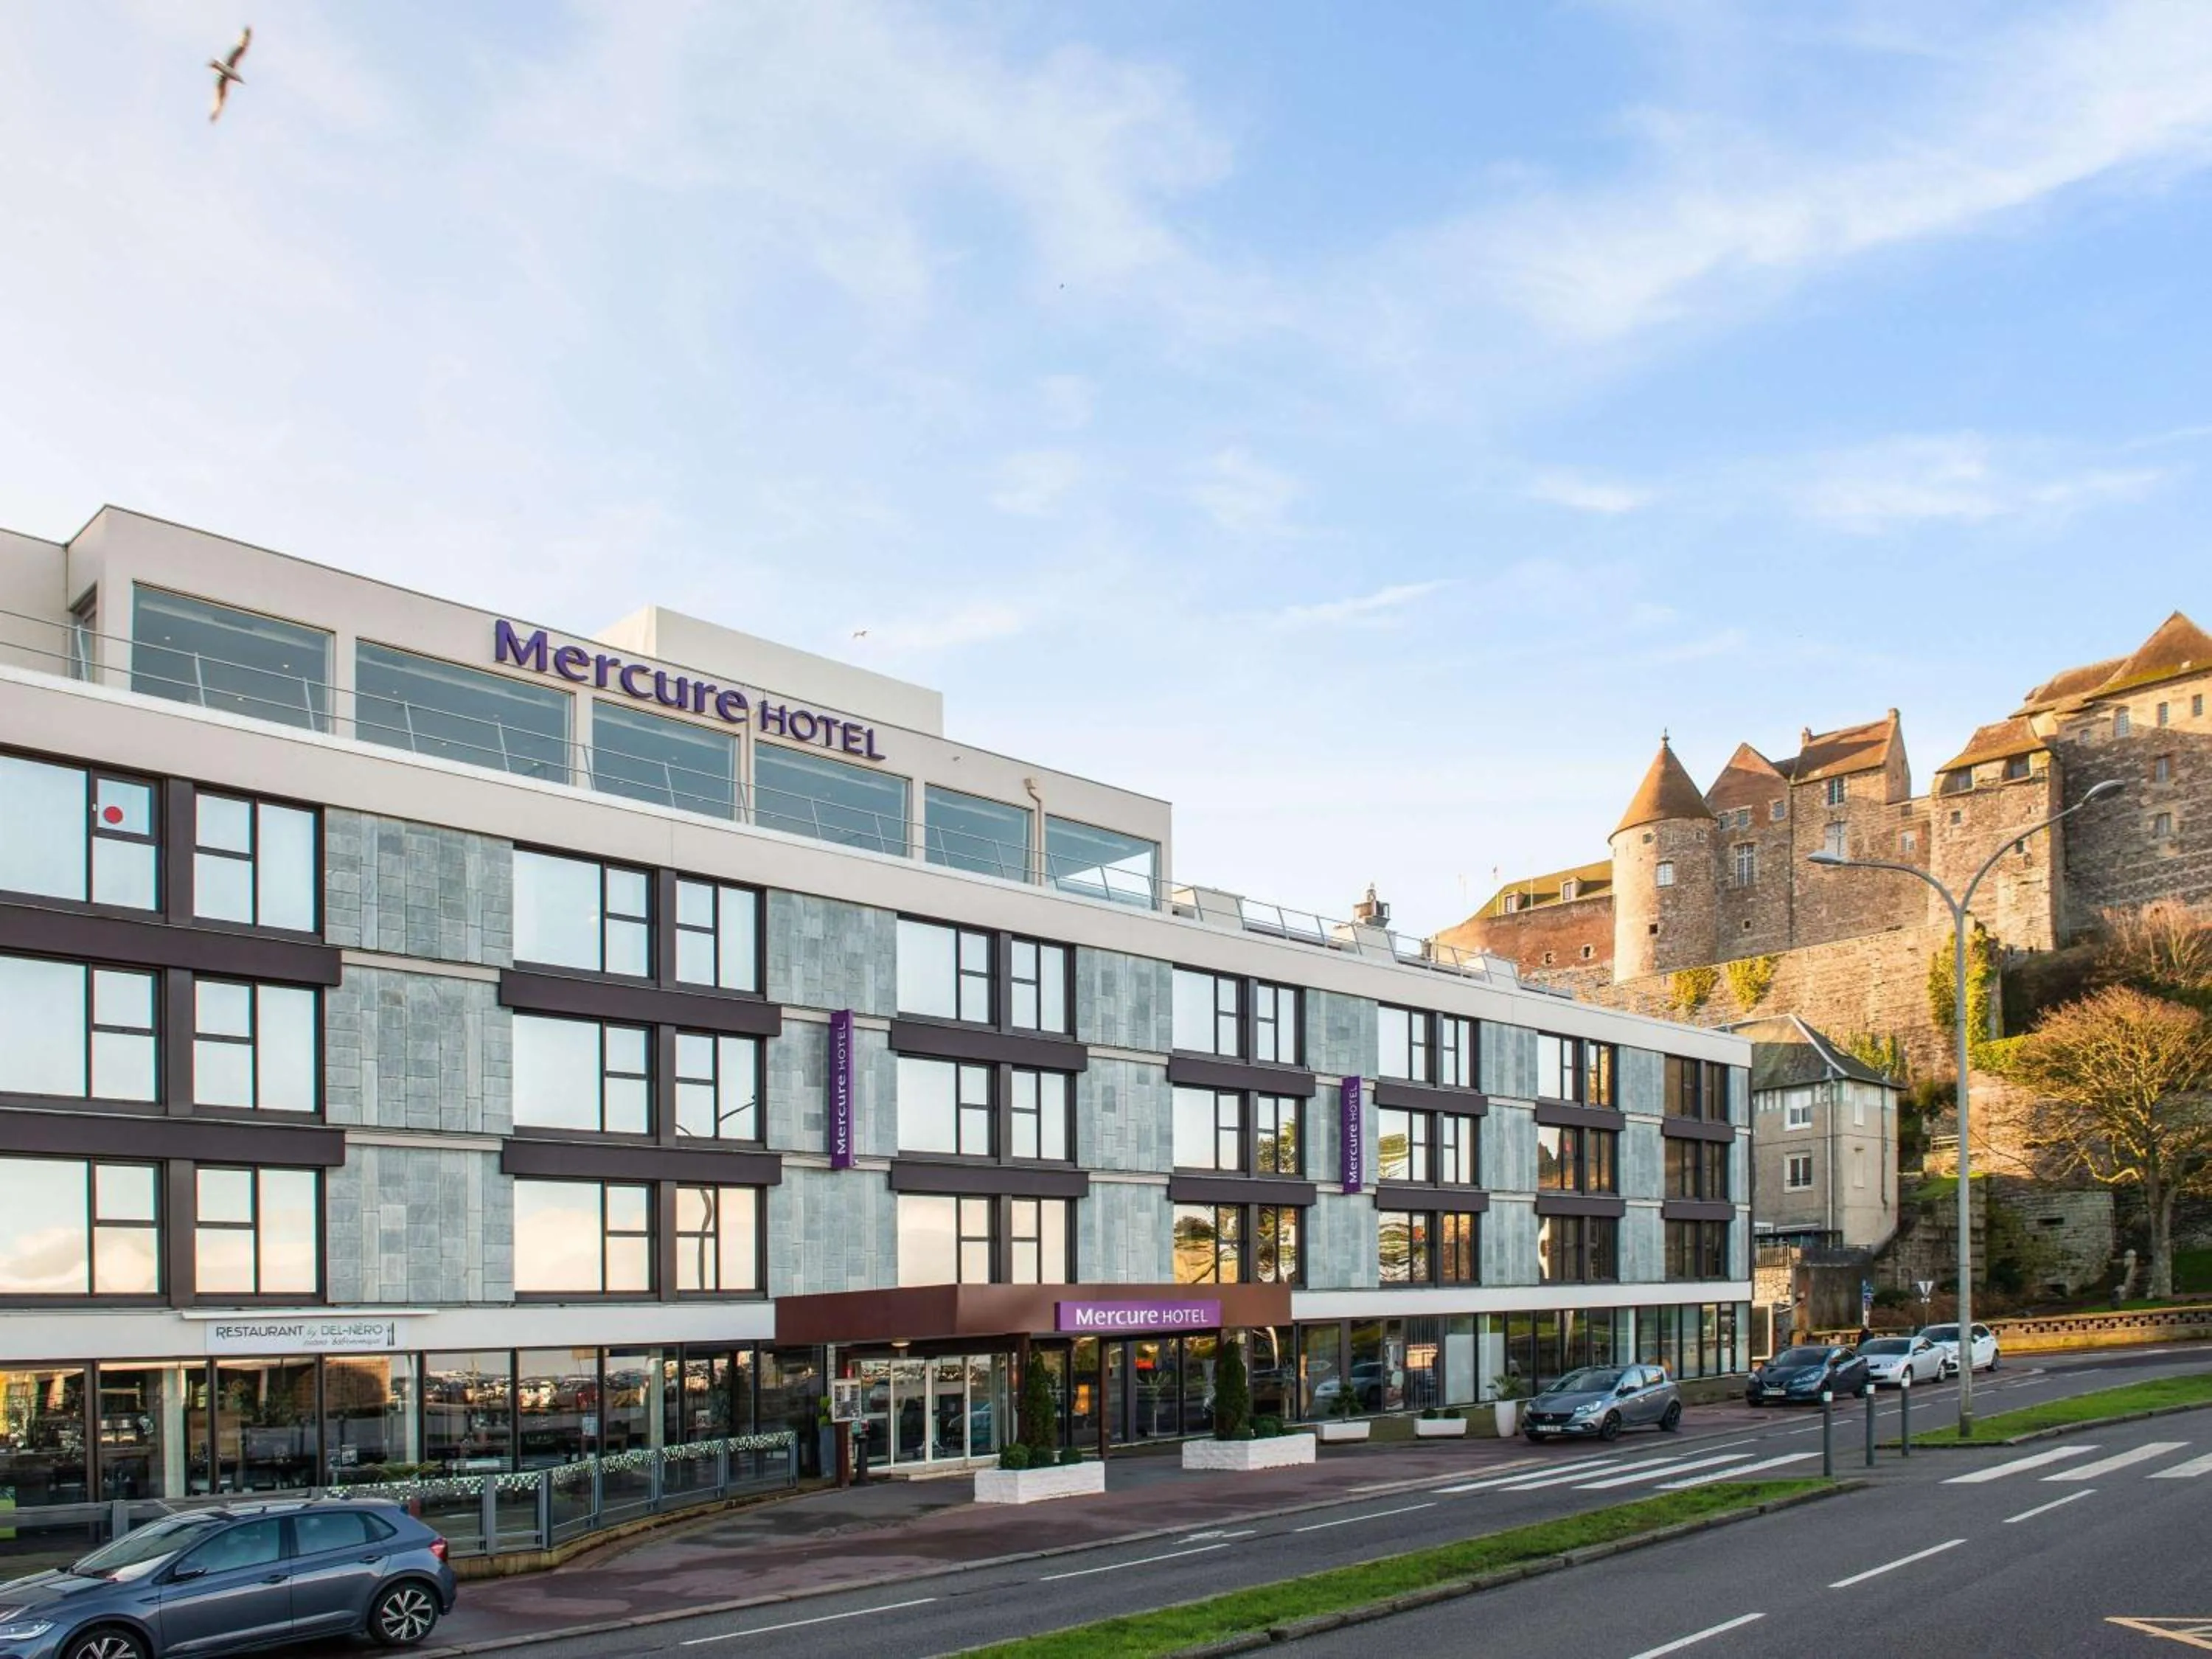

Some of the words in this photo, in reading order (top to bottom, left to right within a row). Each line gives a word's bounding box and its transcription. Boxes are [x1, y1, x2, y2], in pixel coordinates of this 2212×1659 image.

[495, 619, 748, 724] Mercure
[760, 700, 886, 761] HOTEL
[837, 1020, 846, 1069] HOTEL
[837, 1074, 846, 1155] Mercure
[1349, 1085, 1358, 1120] HOTEL
[1349, 1123, 1358, 1183] Mercure
[215, 1325, 305, 1340] RESTAURANT
[1075, 1308, 1158, 1326] Mercure
[1162, 1309, 1208, 1324] HOTEL
